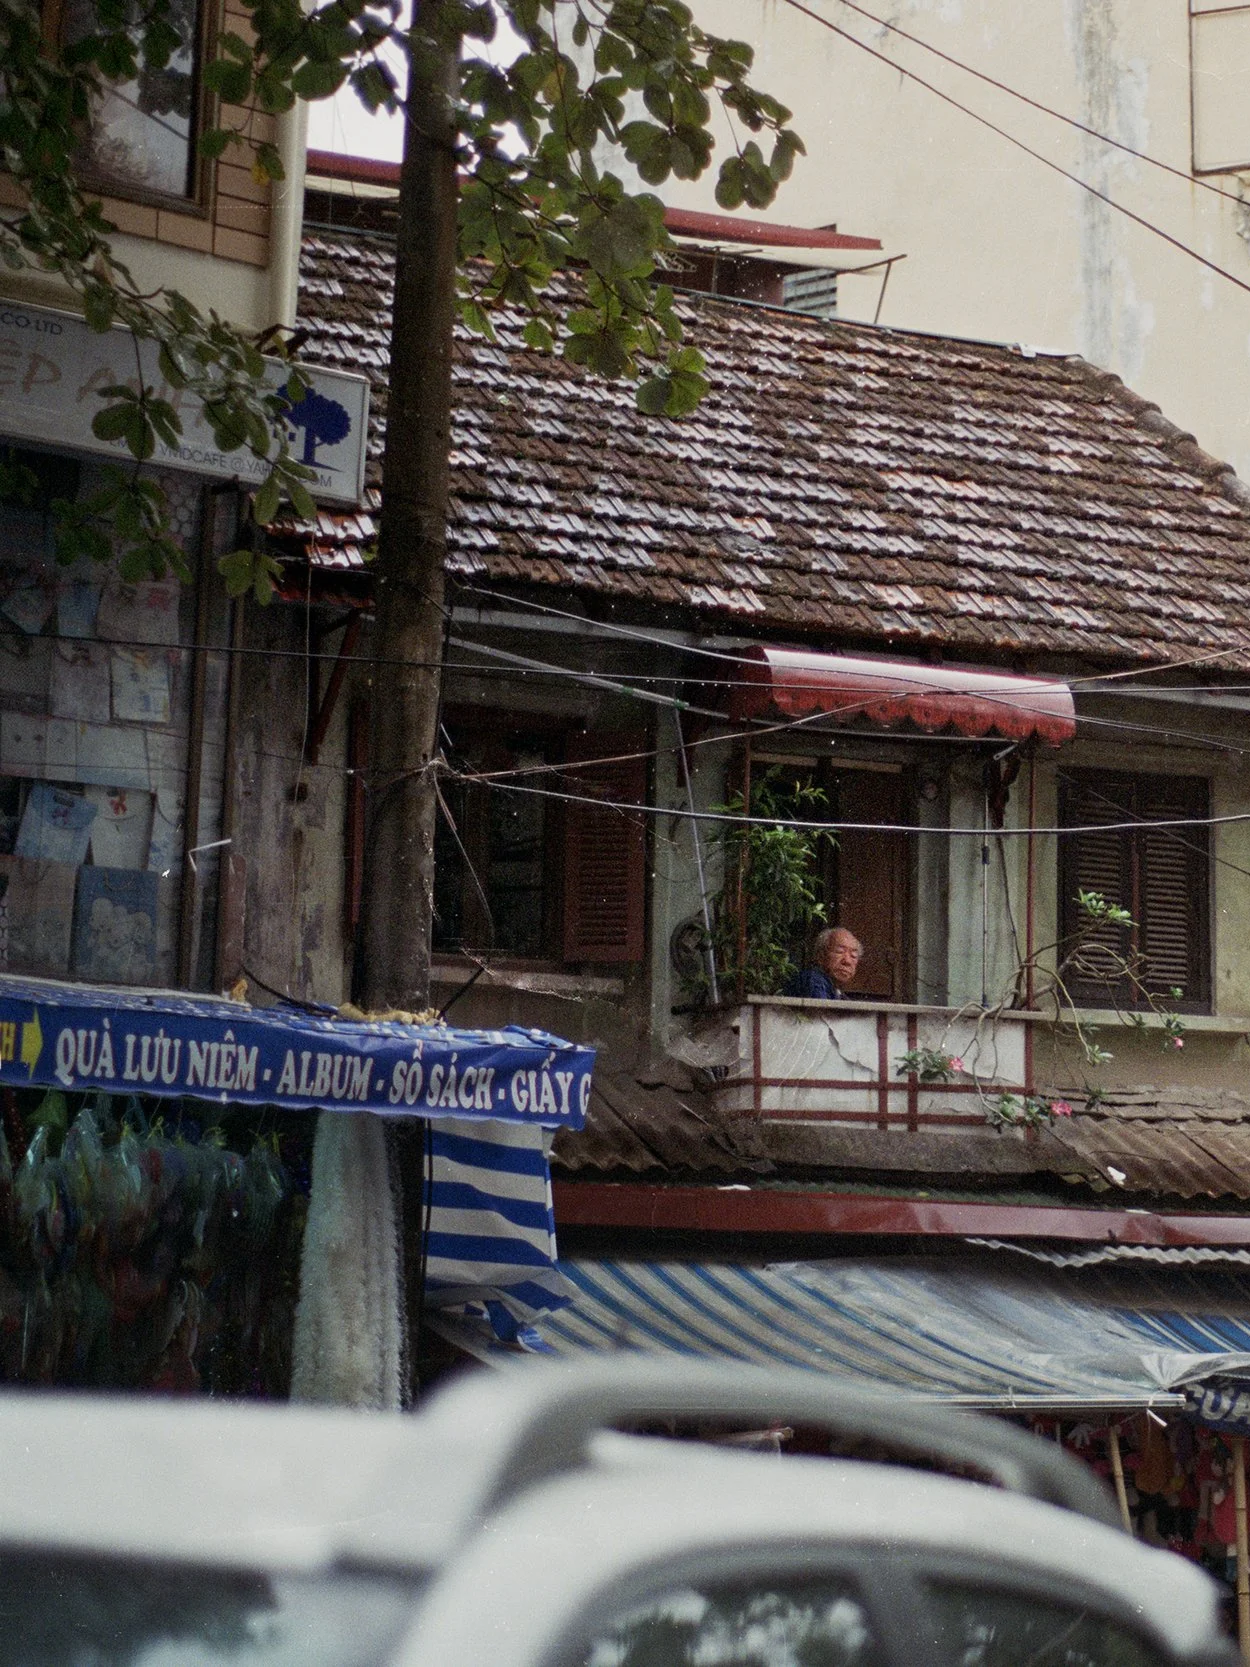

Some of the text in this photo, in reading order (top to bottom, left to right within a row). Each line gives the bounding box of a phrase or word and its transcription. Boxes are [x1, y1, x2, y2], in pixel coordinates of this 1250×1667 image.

[35, 319, 62, 335] LTD
[54, 1017, 116, 1086] QUÀ
[123, 1028, 181, 1085] LƯU
[186, 1029, 258, 1105] NIỆM
[275, 1048, 374, 1102] ALBUM
[388, 1039, 424, 1105] SỔ
[426, 1052, 495, 1110] SÁCH
[511, 1051, 574, 1115] GIẤY
